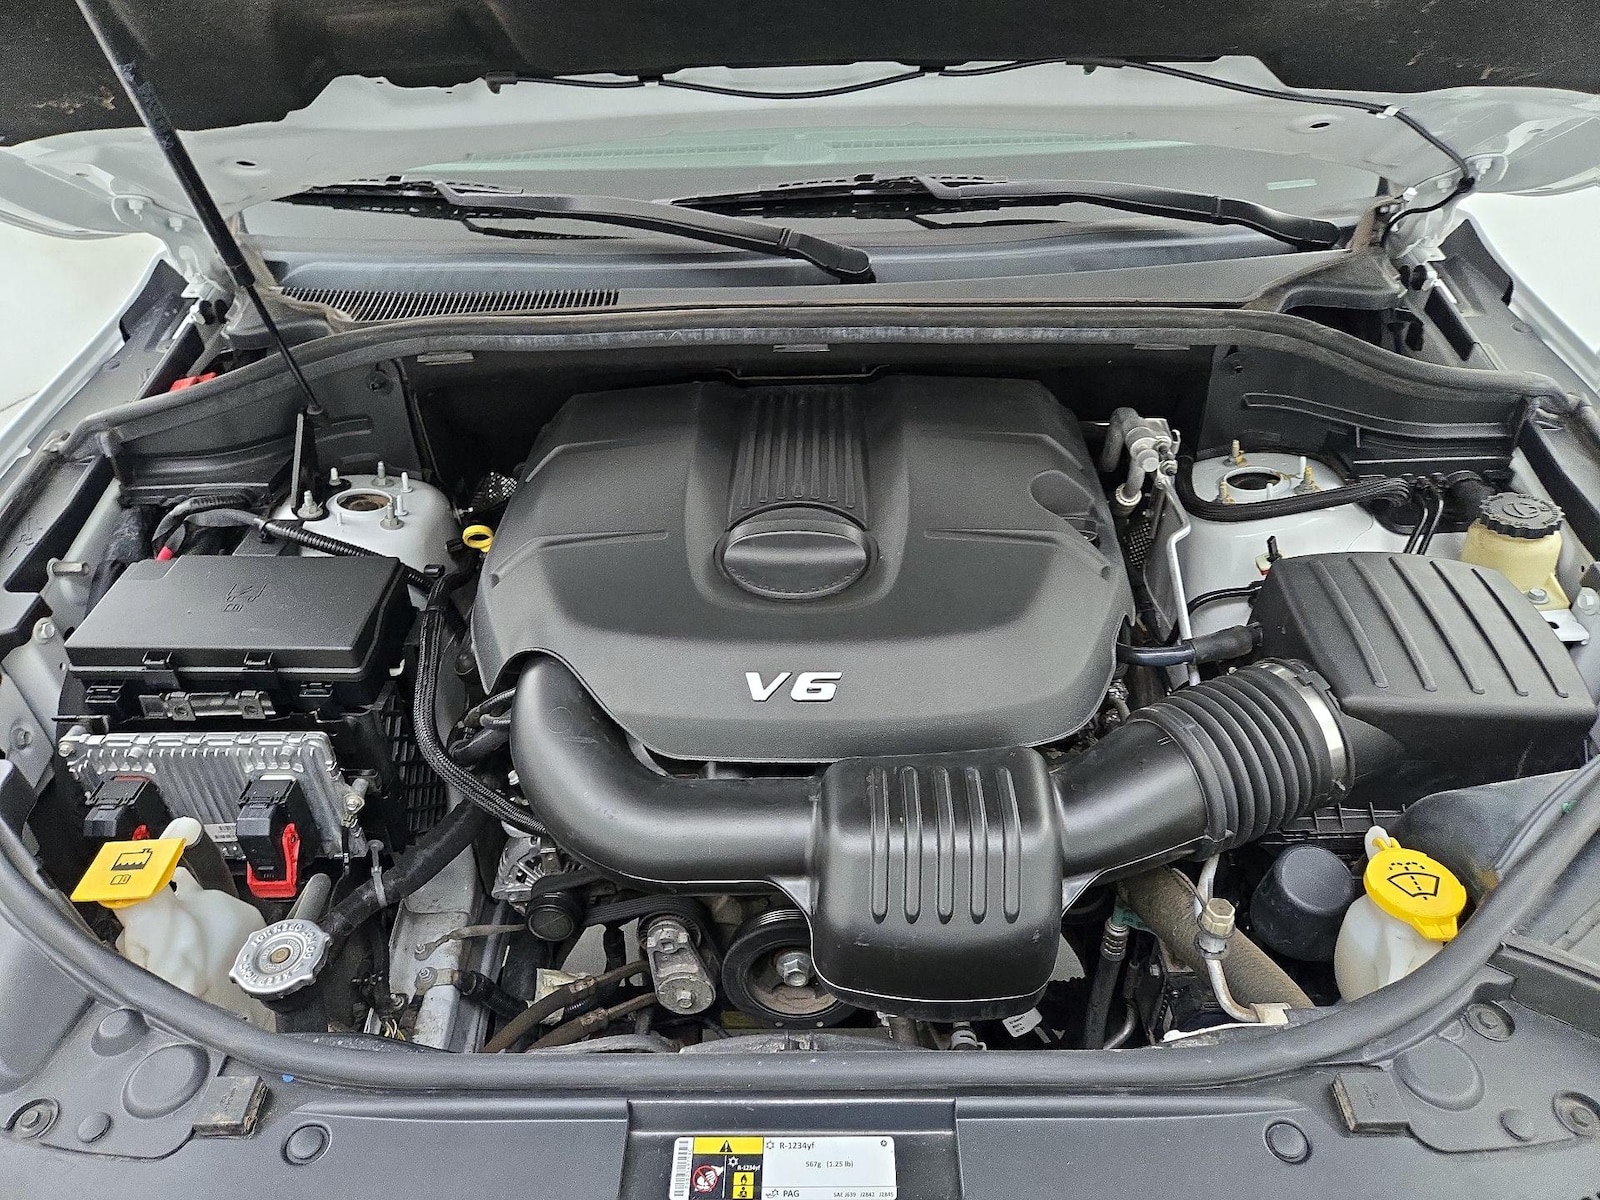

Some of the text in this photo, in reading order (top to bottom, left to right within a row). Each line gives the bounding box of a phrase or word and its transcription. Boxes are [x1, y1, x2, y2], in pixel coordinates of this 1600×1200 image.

[745, 672, 843, 702] V6
[779, 1141, 815, 1150] R-1234yf
[737, 1164, 761, 1172] R-1234yf
[805, 1161, 822, 1169] 567g
[783, 1190, 800, 1198] PAG
